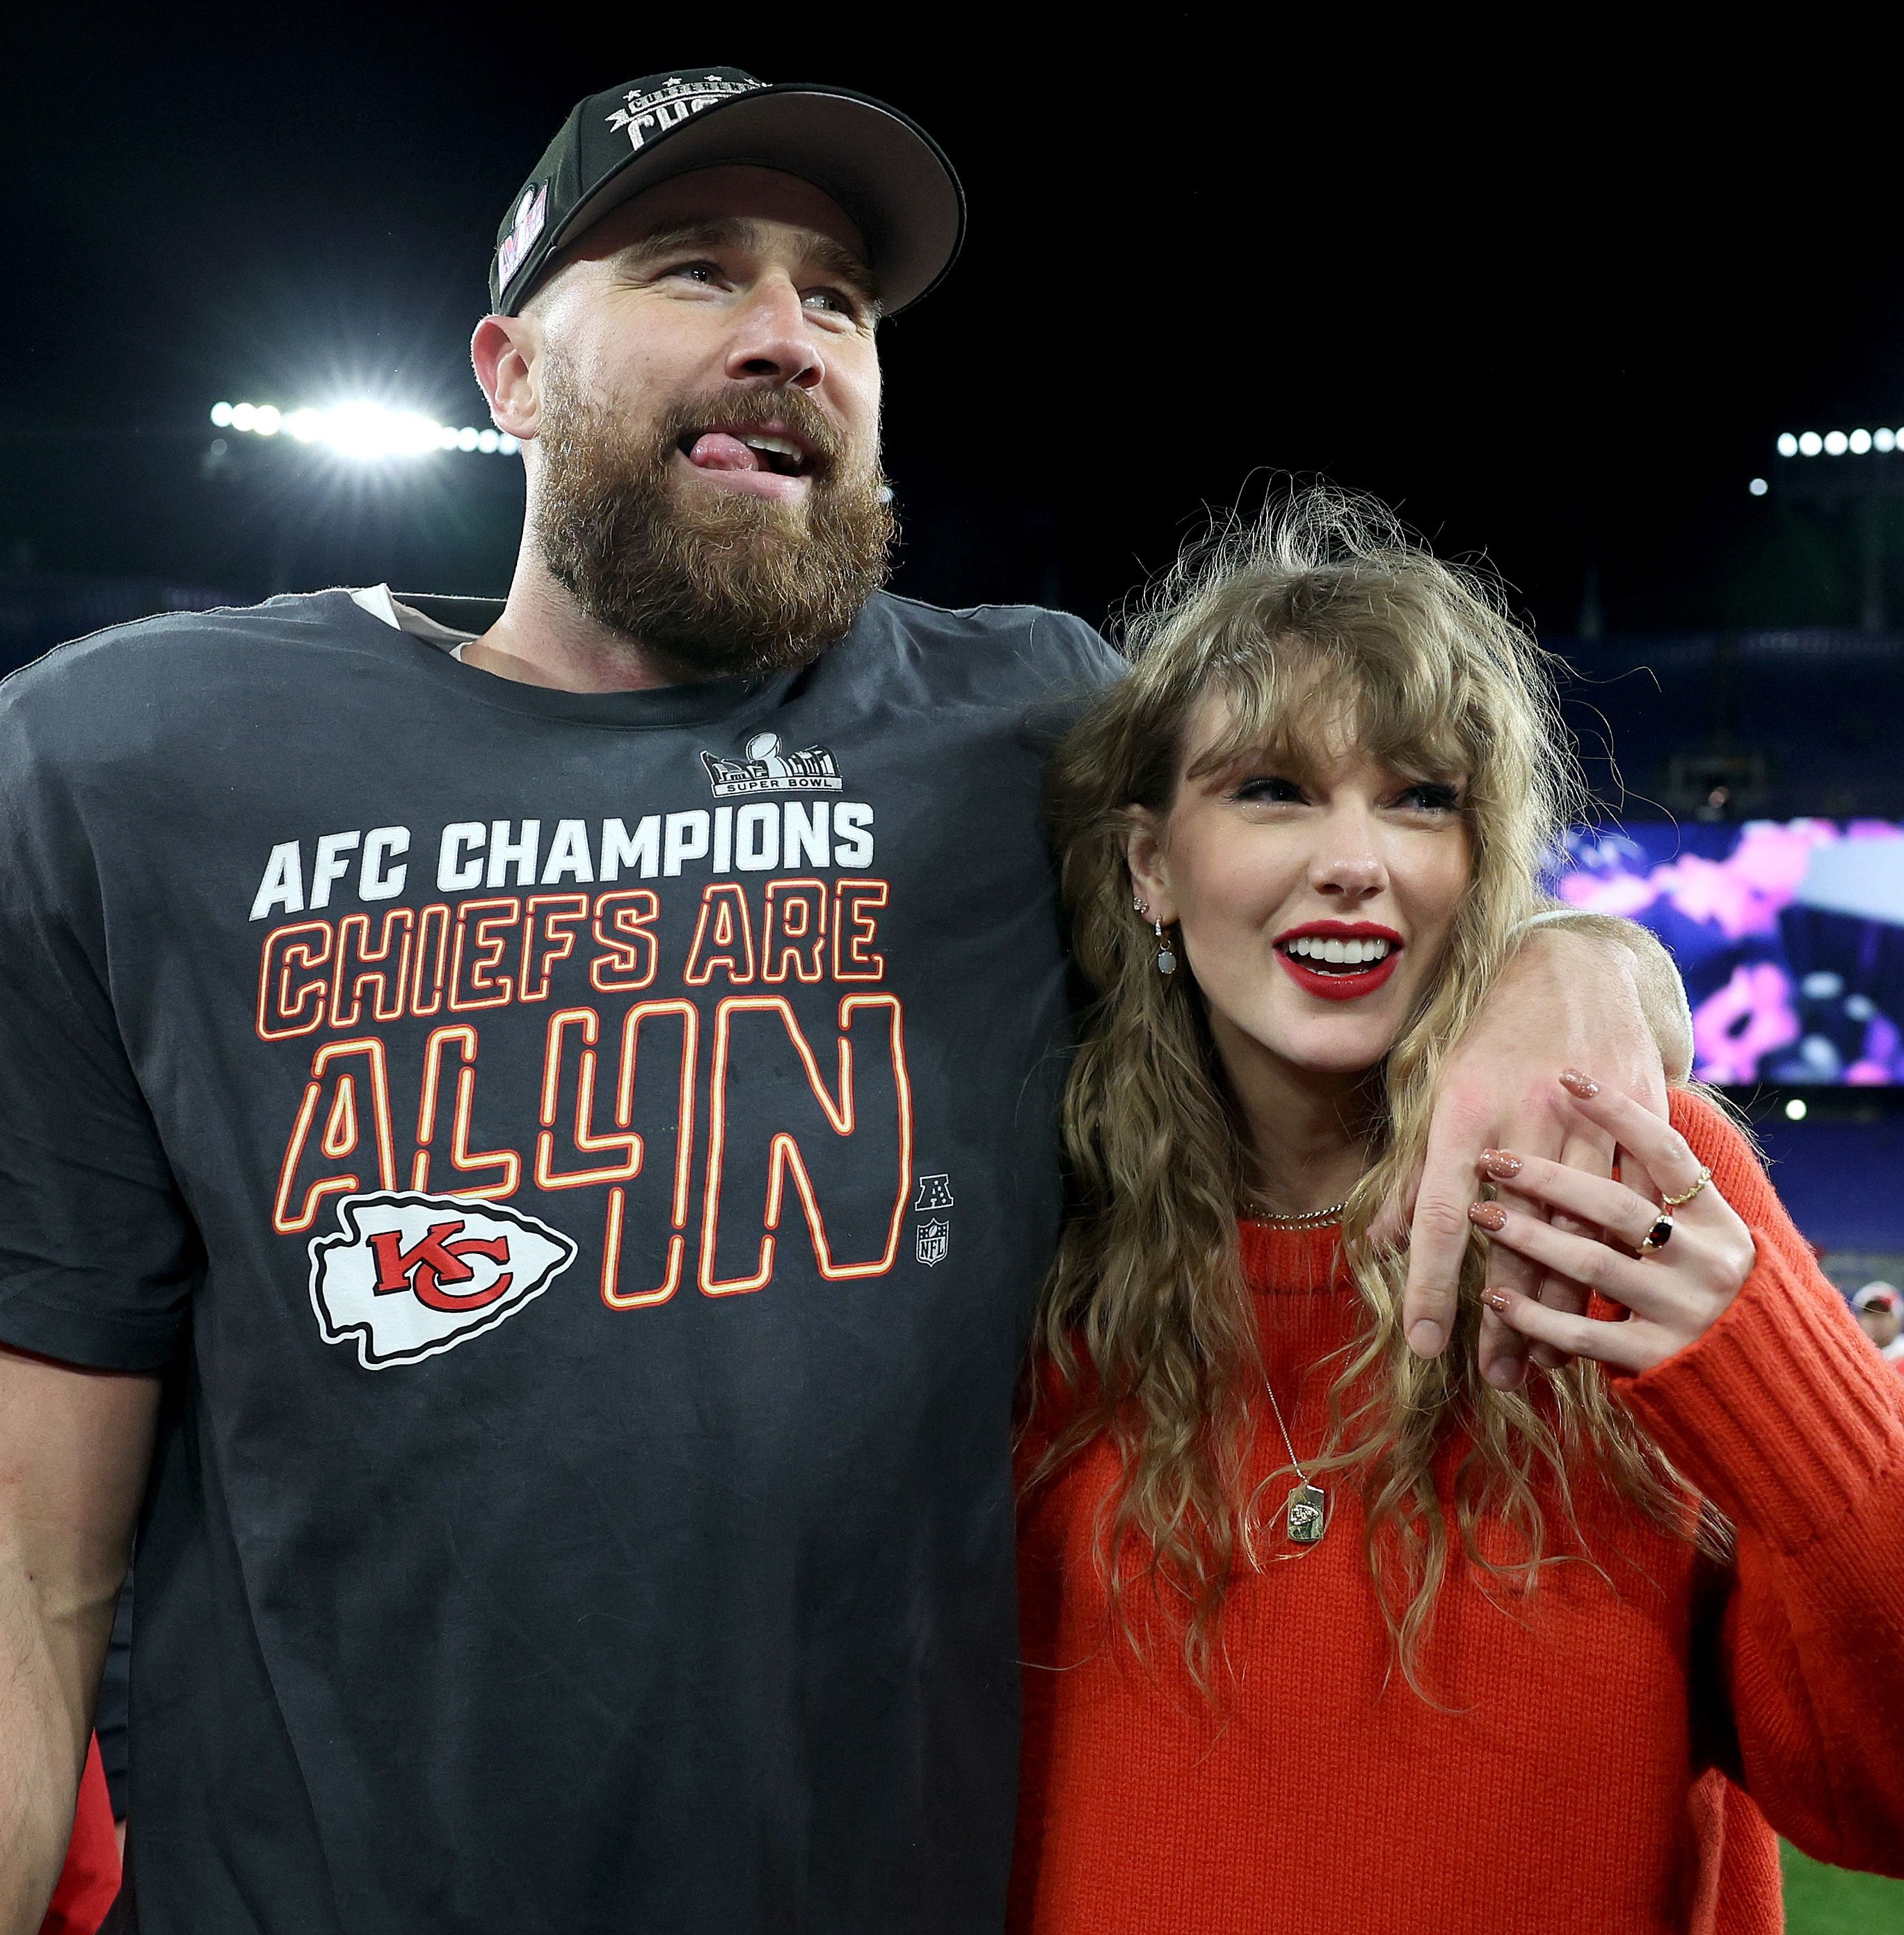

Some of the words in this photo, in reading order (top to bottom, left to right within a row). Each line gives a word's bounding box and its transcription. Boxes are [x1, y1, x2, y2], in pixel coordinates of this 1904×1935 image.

[727, 780, 780, 792] SUPER
[789, 778, 832, 787] BOWL
[249, 826, 410, 922] AFC
[436, 801, 874, 892] CHAMPIONS
[256, 888, 659, 1041] CHIEFS
[683, 876, 890, 986] ARE
[271, 1006, 644, 1235] ALL
[601, 993, 914, 1311] IN
[366, 1220, 514, 1313] KC
[920, 1238, 945, 1260] NFL
